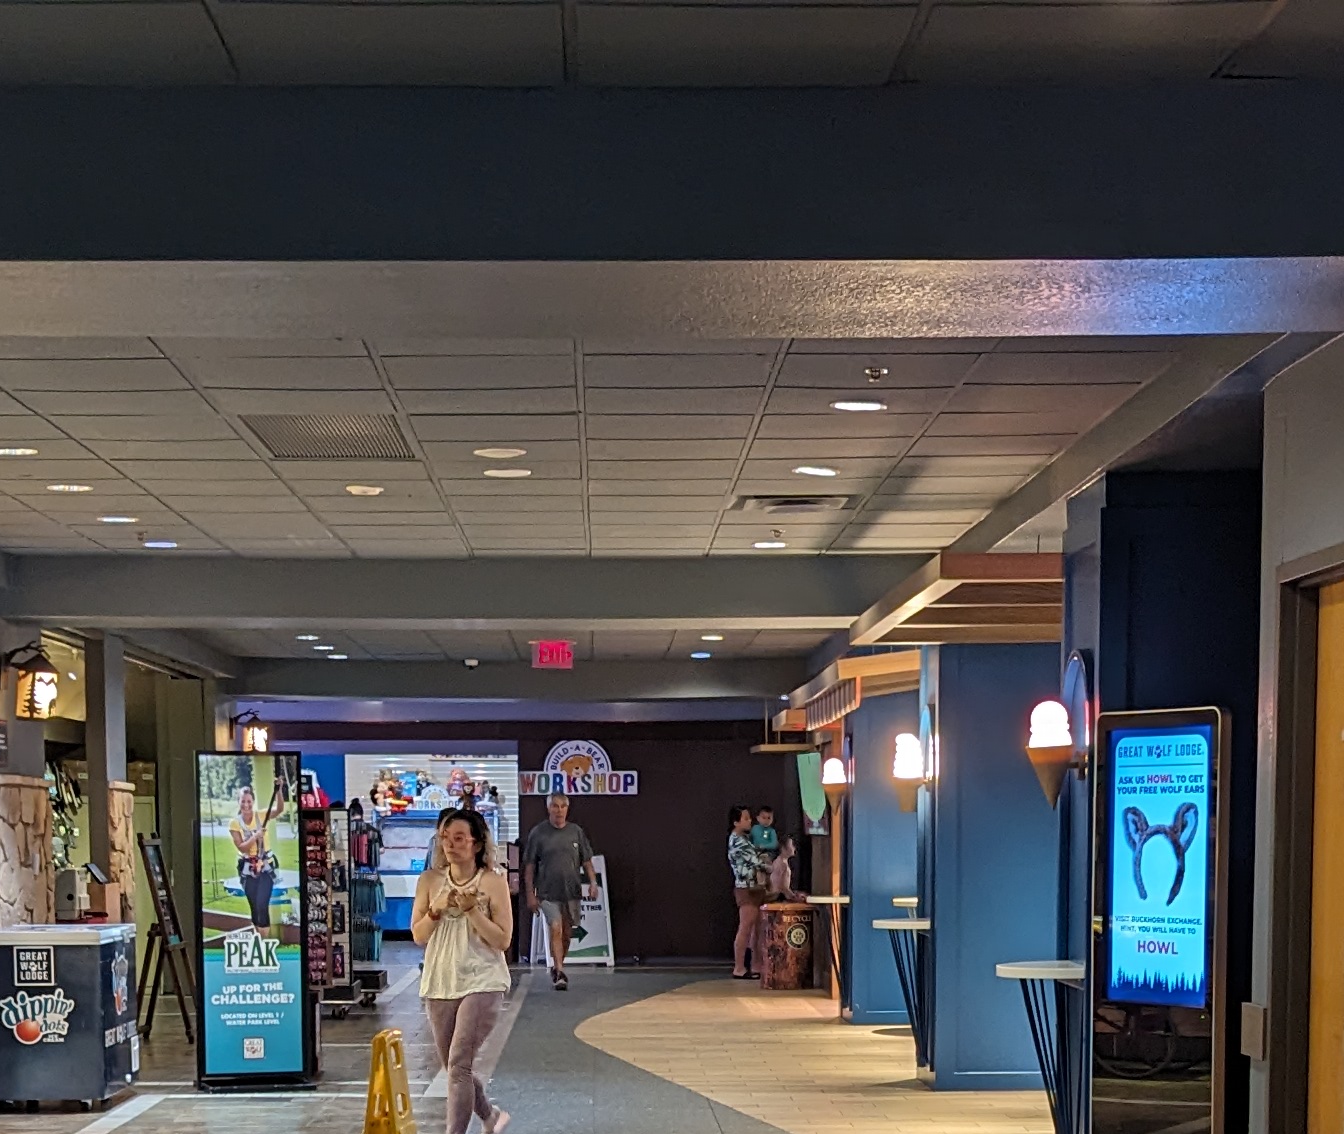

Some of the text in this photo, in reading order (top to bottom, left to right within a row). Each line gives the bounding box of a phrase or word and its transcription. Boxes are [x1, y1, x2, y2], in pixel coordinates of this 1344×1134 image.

[550, 744, 606, 770] BUILD-A-BEAR
[1118, 746, 1143, 758] GREAT
[519, 773, 635, 793] WORKSHOP
[1118, 775, 1204, 784] ASK US HOWL TO GET
[1139, 786, 1158, 794] FREE
[1160, 786, 1183, 794] WOLF
[1184, 785, 1205, 793] EARS
[226, 935, 278, 967] PEAK
[1137, 940, 1178, 955] HOWL
[19, 951, 48, 961] GREAT
[20, 971, 48, 980] LODGE
[222, 982, 283, 994] UP FOR THE
[211, 993, 295, 1005] CHALLENGE?
[40, 1019, 67, 1033] dots
